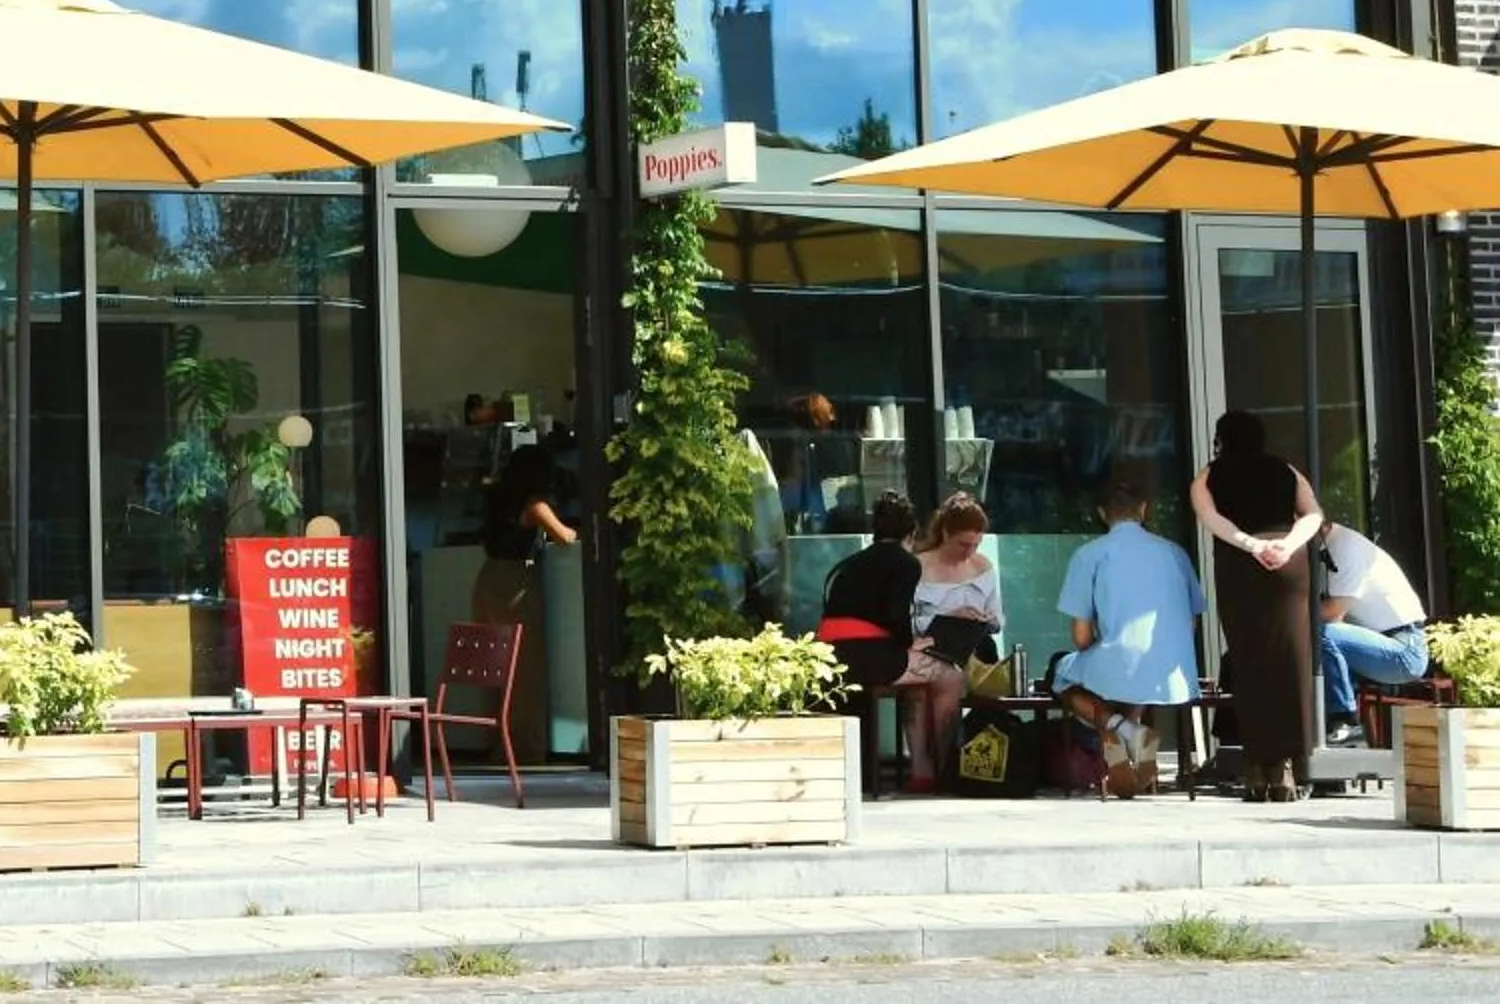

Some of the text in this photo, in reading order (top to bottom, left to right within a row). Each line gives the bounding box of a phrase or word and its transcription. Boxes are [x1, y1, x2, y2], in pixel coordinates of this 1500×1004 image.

[644, 146, 722, 183] Poppies.
[264, 548, 349, 569] COFFEE
[269, 578, 346, 598] LUNCH
[278, 608, 339, 628] WINE
[275, 638, 344, 659] NIGHT
[281, 668, 343, 689] BITES
[287, 729, 342, 751] BER
